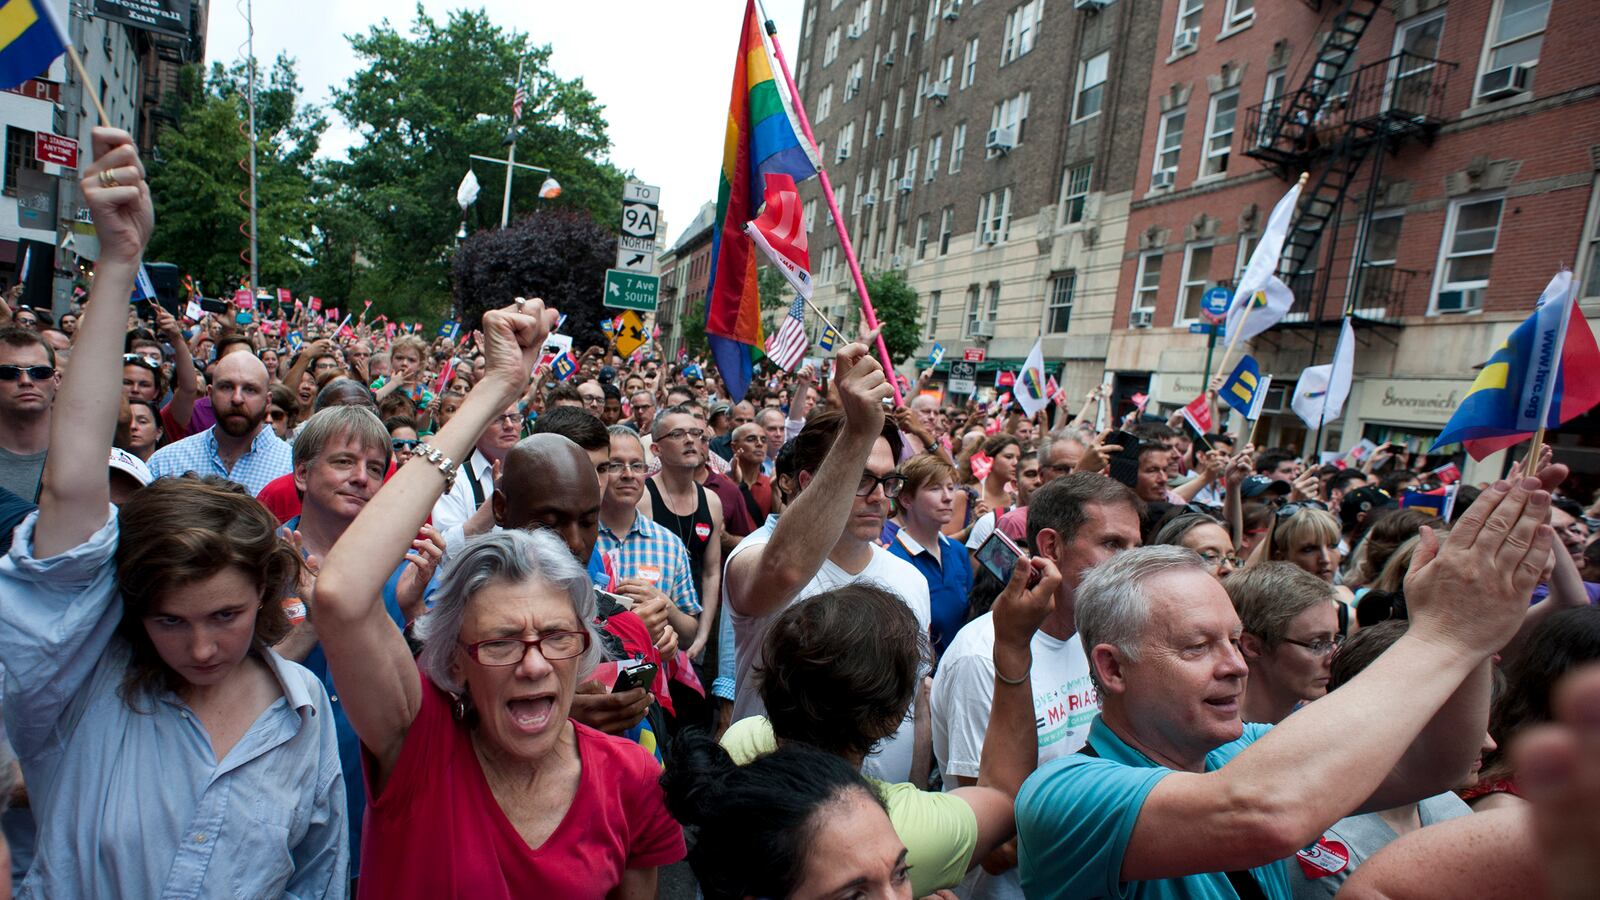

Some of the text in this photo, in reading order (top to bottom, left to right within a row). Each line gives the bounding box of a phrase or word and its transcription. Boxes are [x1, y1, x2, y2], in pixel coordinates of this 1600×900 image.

[106, 0, 182, 21] tonewall
[128, 10, 157, 24] Inn
[39, 133, 76, 149] NO STANDING
[43, 143, 72, 156] ANYTIME
[635, 187, 650, 199] TO
[625, 209, 652, 232] 9A
[621, 238, 653, 251] NORTH
[626, 279, 655, 291] 7 Ave
[624, 292, 655, 304] SOUTH
[1524, 329, 1556, 419] www.hrc.org
